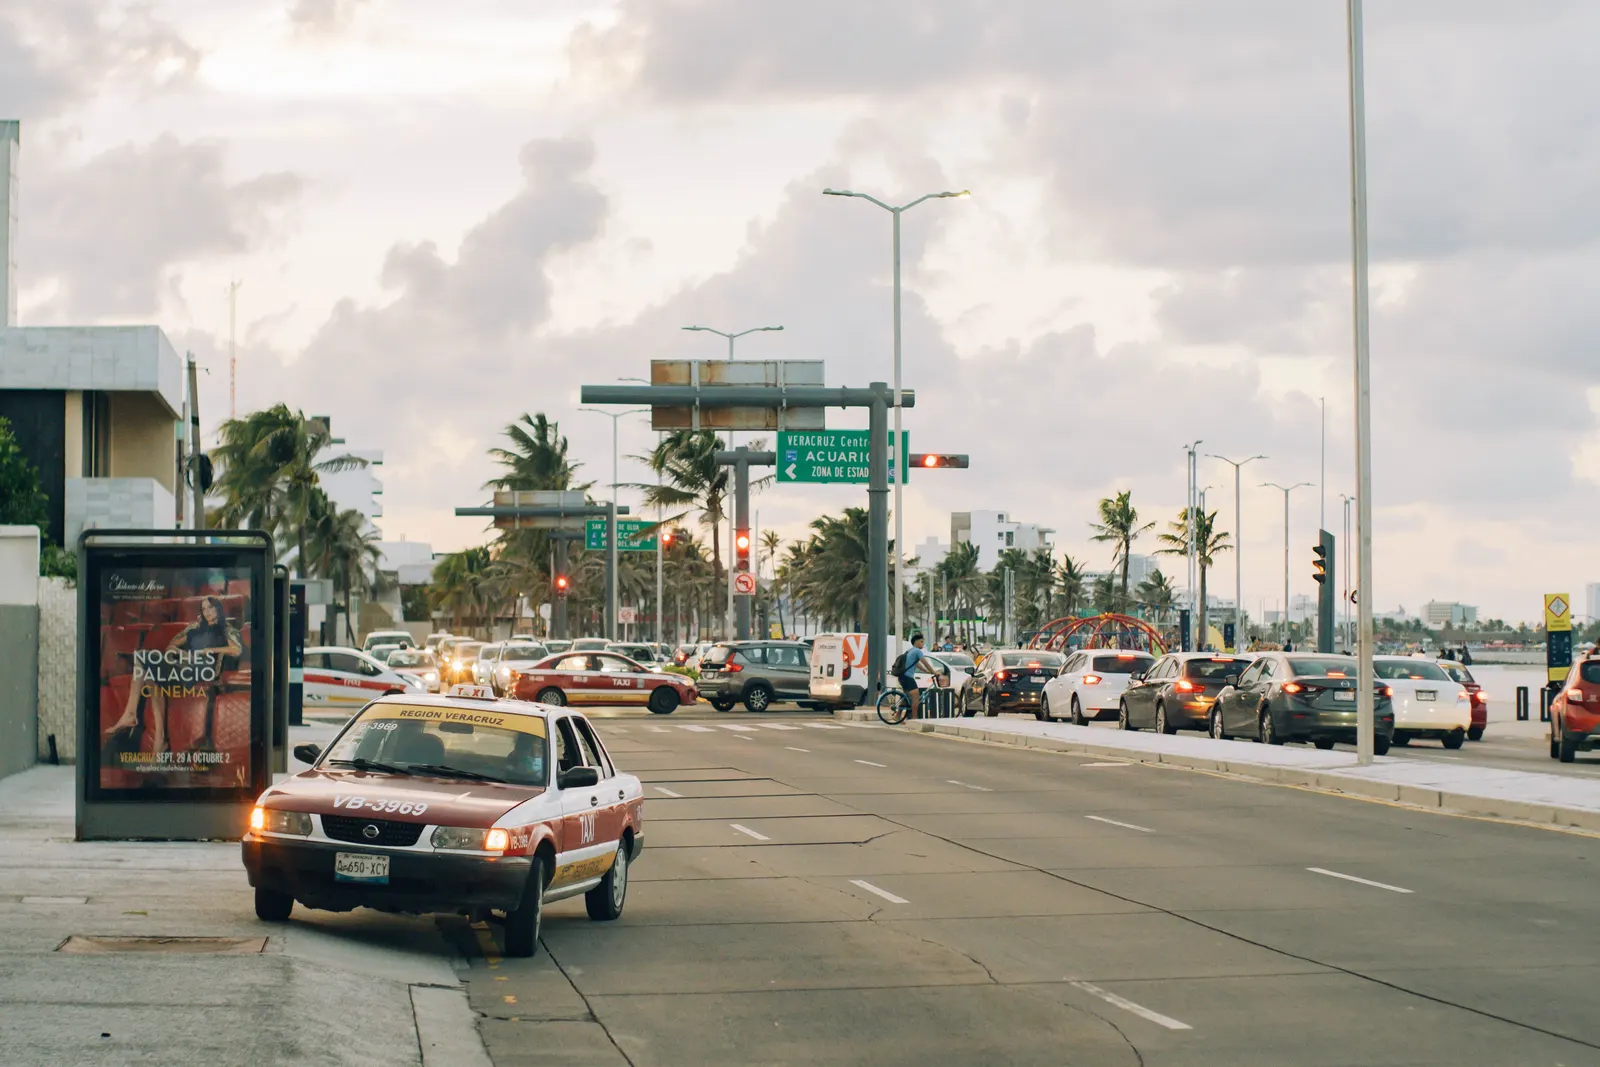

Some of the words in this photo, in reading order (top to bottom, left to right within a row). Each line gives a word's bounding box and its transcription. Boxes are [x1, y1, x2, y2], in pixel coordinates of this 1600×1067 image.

[787, 435, 835, 447] VERACRUZ
[840, 435, 870, 447] Centr
[811, 466, 832, 477] ZONA
[834, 466, 844, 477] DE
[847, 466, 870, 478] ESTAD
[133, 649, 215, 665] NOCHES
[133, 666, 215, 682] PALACIO
[612, 678, 631, 686] TAXI
[141, 685, 207, 698] CINEMA
[457, 688, 485, 697] TXI
[400, 710, 442, 718] REGION
[445, 712, 504, 726] VERACRUZ
[119, 752, 155, 763] VERACRUZ
[156, 752, 175, 763] SEPT.
[176, 752, 185, 763] 29
[186, 752, 192, 763] A
[192, 752, 224, 763] OCTUBRE
[225, 752, 230, 763] 2
[333, 794, 428, 816] VB-3969
[579, 814, 595, 845] TAXI
